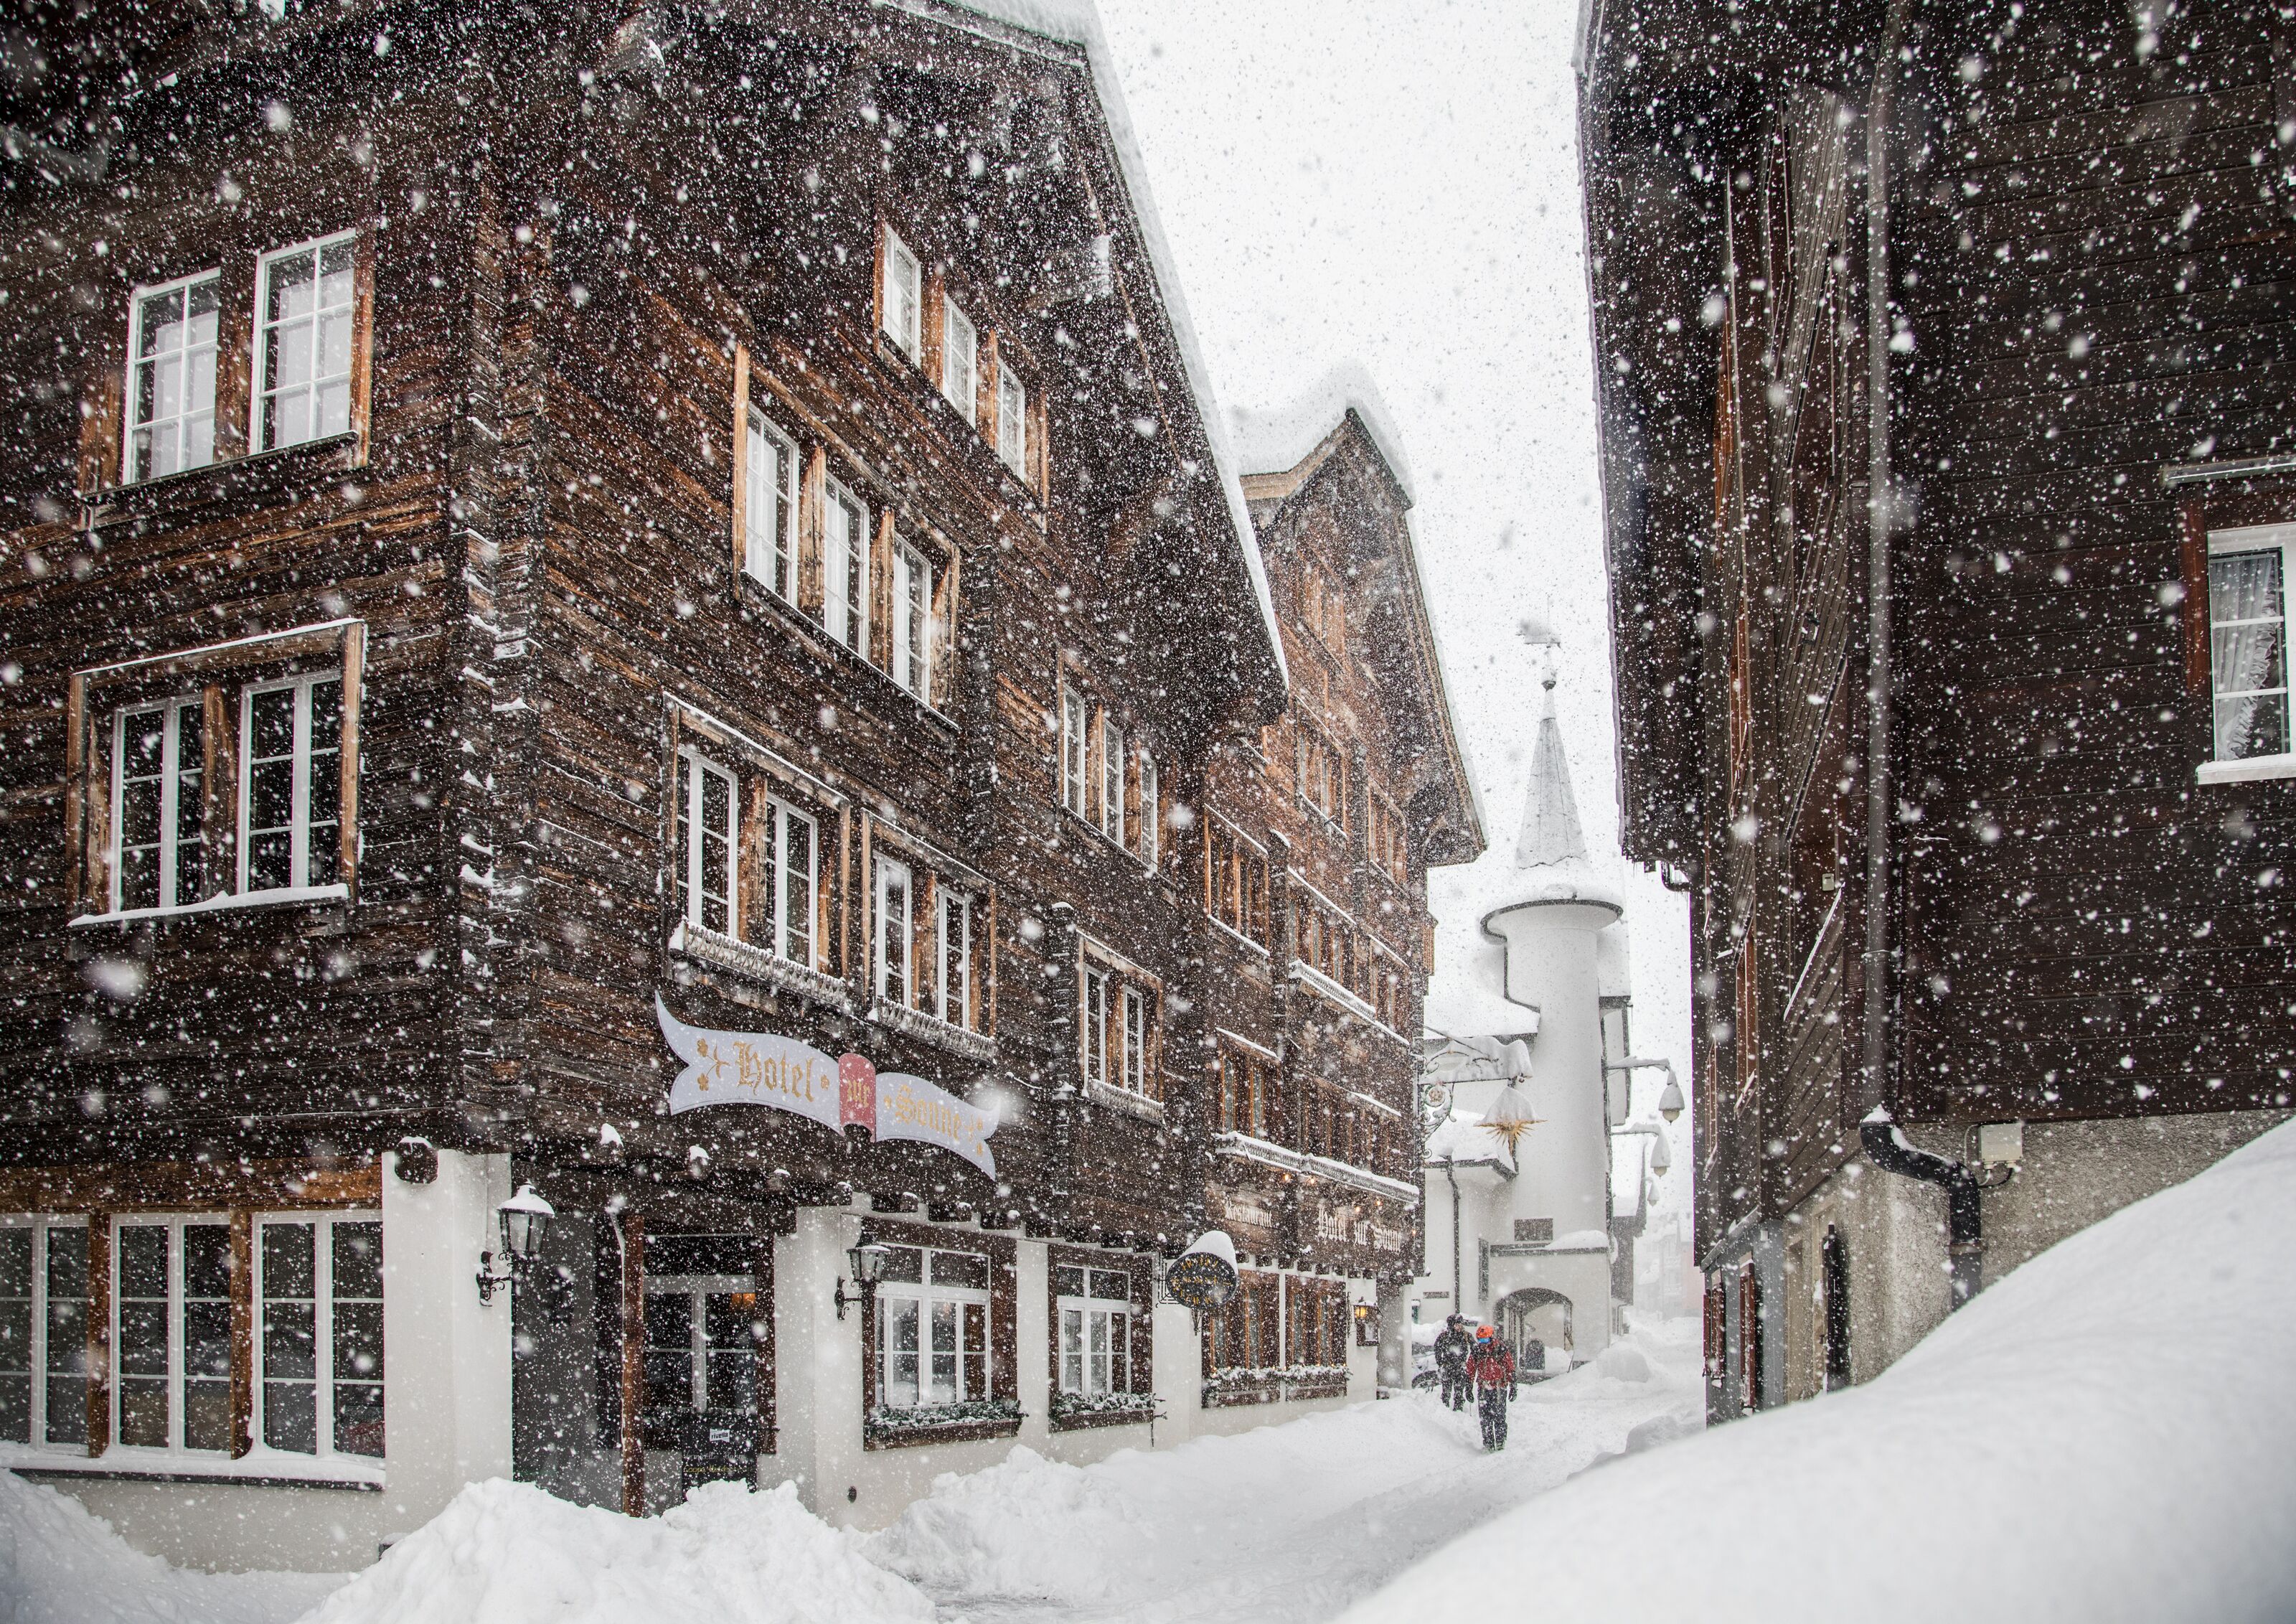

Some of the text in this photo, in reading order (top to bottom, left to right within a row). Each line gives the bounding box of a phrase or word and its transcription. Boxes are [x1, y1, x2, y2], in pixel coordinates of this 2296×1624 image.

[733, 1041, 815, 1103] Hotel
[895, 1084, 962, 1141] Sonne
[1224, 1198, 1272, 1228] Restaurant
